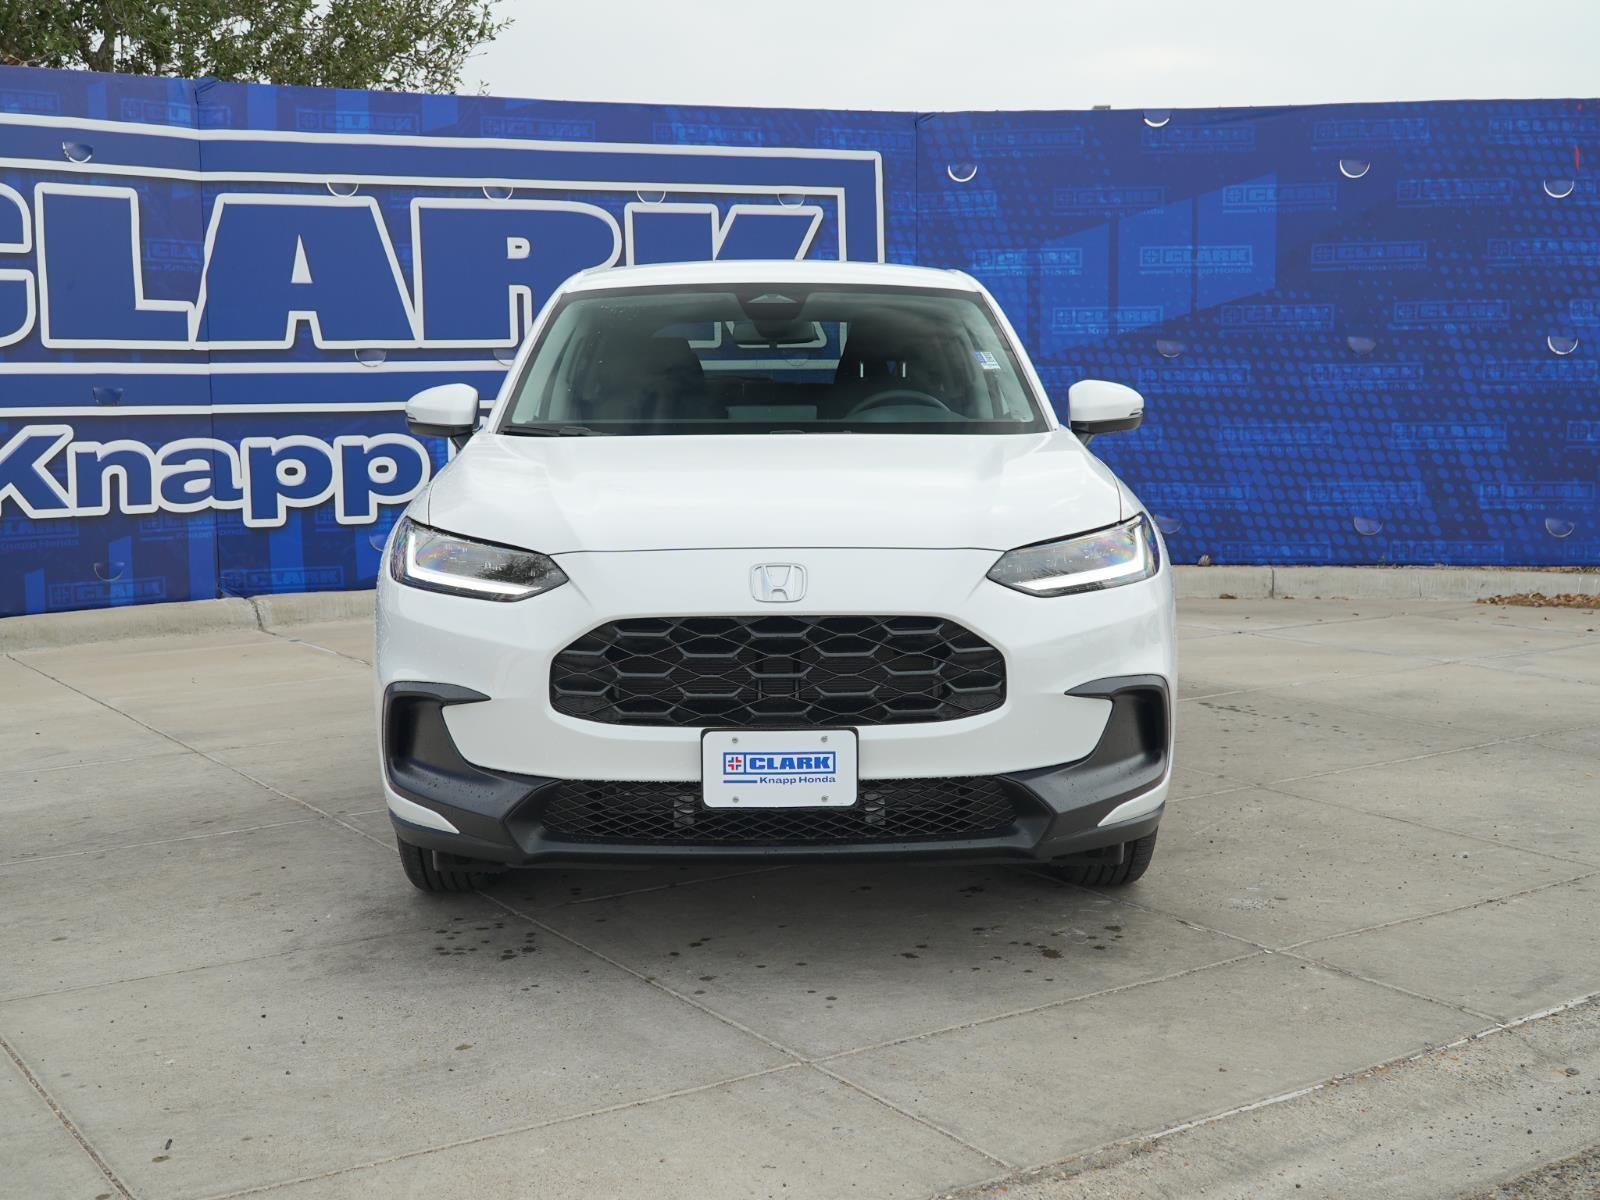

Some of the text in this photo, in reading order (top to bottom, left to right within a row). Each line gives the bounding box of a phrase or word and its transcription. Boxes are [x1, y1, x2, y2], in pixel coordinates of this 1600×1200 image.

[1165, 248, 1248, 262] CLARK
[0, 183, 824, 349] LARK
[0, 424, 431, 528] Knapp
[749, 756, 831, 770] CLARK
[759, 775, 836, 785] Knapp Honda
